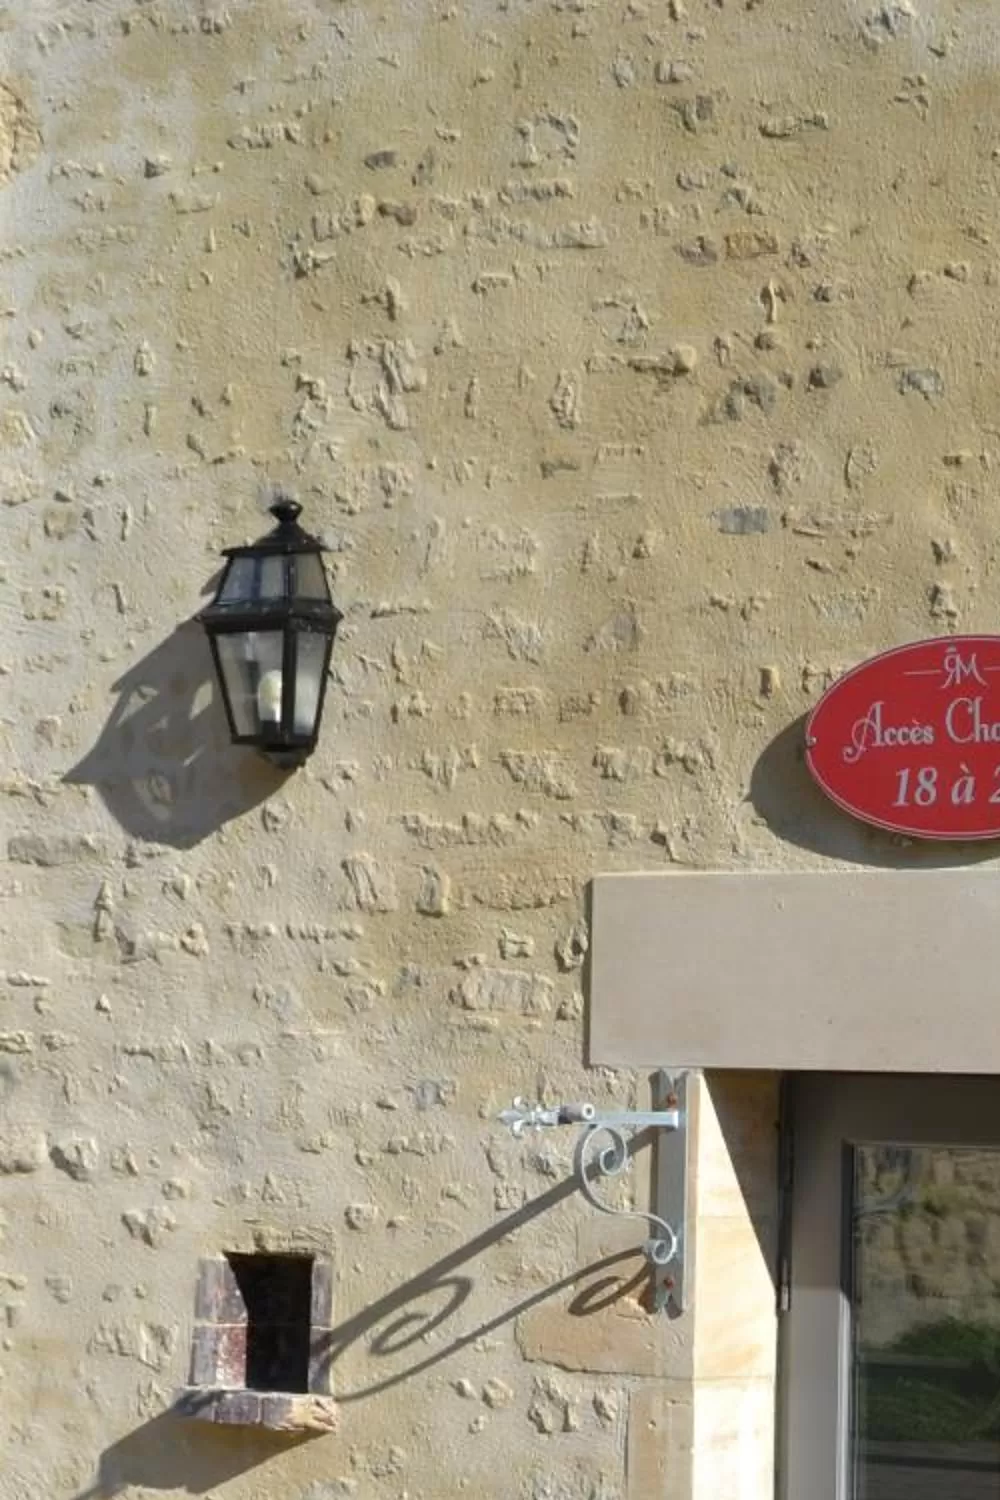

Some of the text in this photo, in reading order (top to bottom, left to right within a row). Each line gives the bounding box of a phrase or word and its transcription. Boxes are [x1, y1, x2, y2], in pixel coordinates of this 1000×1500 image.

[843, 701, 934, 763] Accès
[893, 767, 938, 807] 18
[952, 763, 977, 805] à
